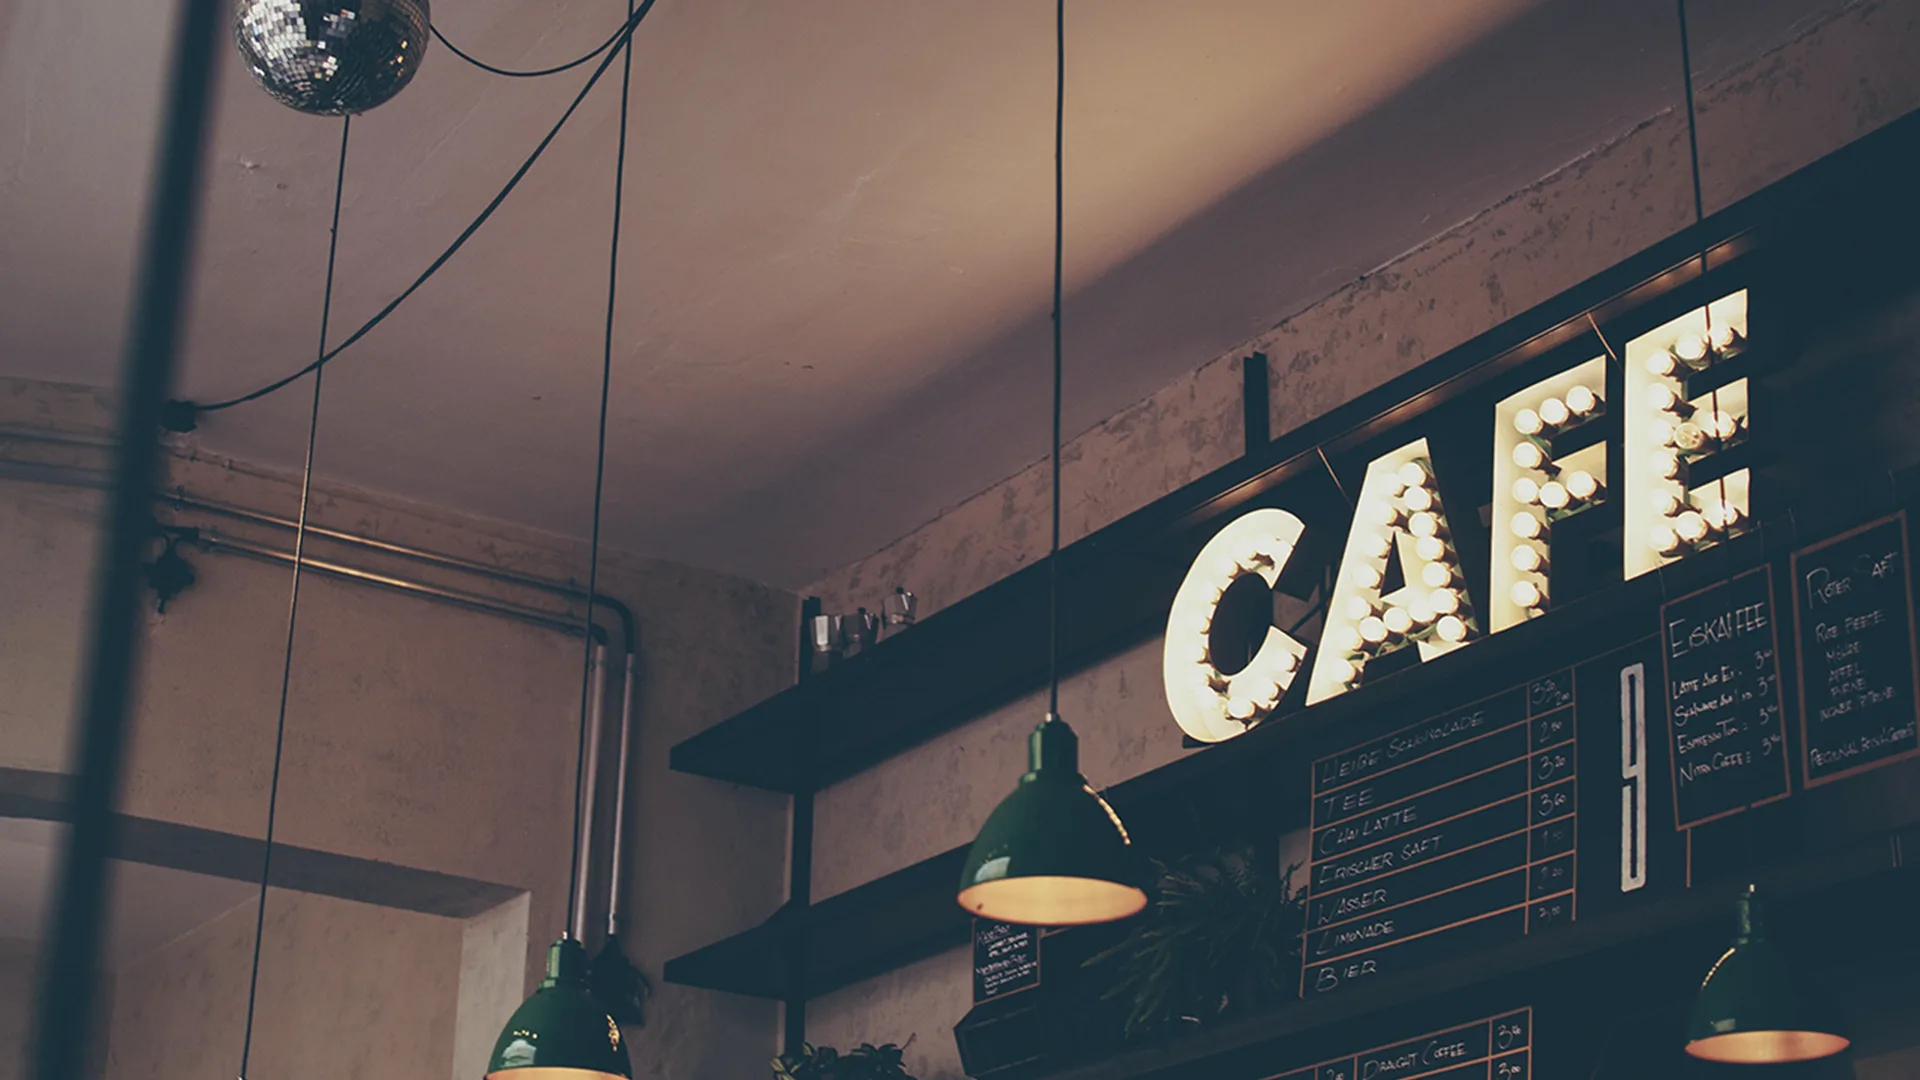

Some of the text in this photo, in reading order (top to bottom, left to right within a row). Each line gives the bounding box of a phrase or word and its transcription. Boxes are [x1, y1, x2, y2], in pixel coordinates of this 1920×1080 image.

[1163, 288, 1750, 744] CAFE
[1323, 787, 1374, 820] TEE
[1361, 806, 1418, 836] LATTE
[1317, 888, 1388, 925] WASSER
[1315, 920, 1395, 955] LIMONADE
[1315, 960, 1378, 992] BIER
[1421, 1040, 1469, 1066] COFFEE
